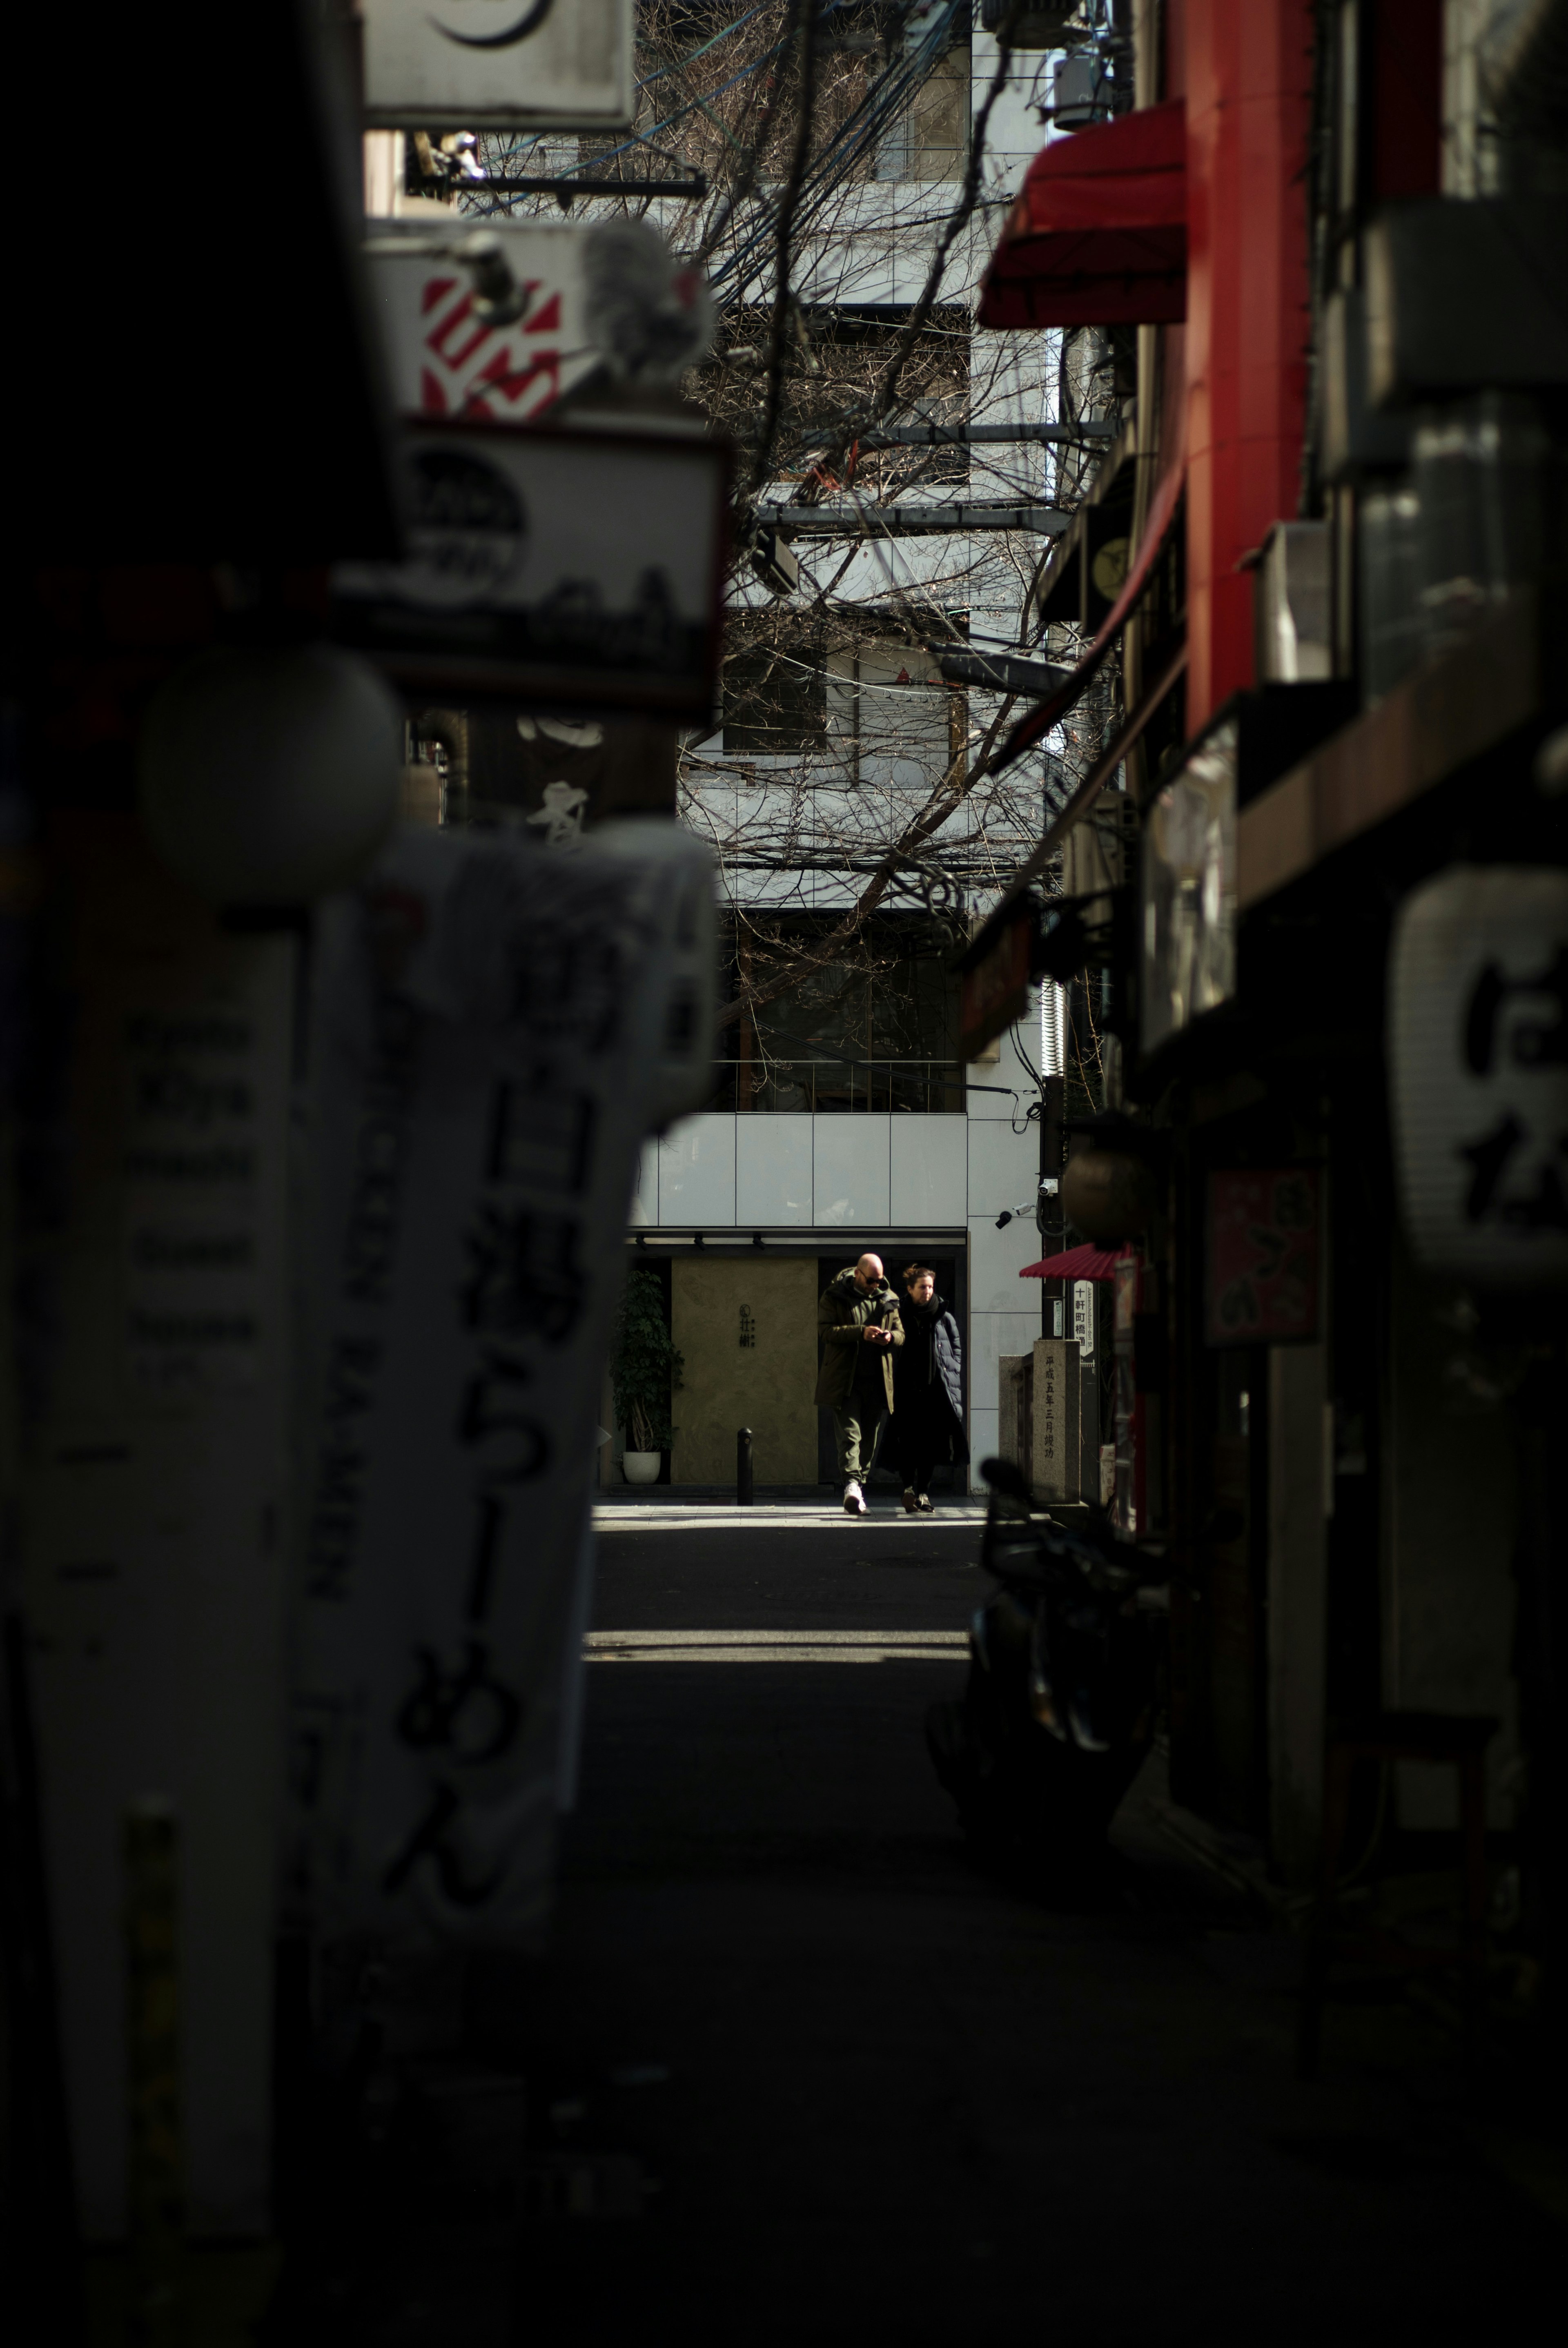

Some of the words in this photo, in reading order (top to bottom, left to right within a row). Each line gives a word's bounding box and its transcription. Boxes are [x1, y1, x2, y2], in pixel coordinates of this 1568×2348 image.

[1045, 1356, 1054, 1459] 平成五年三月竣功
